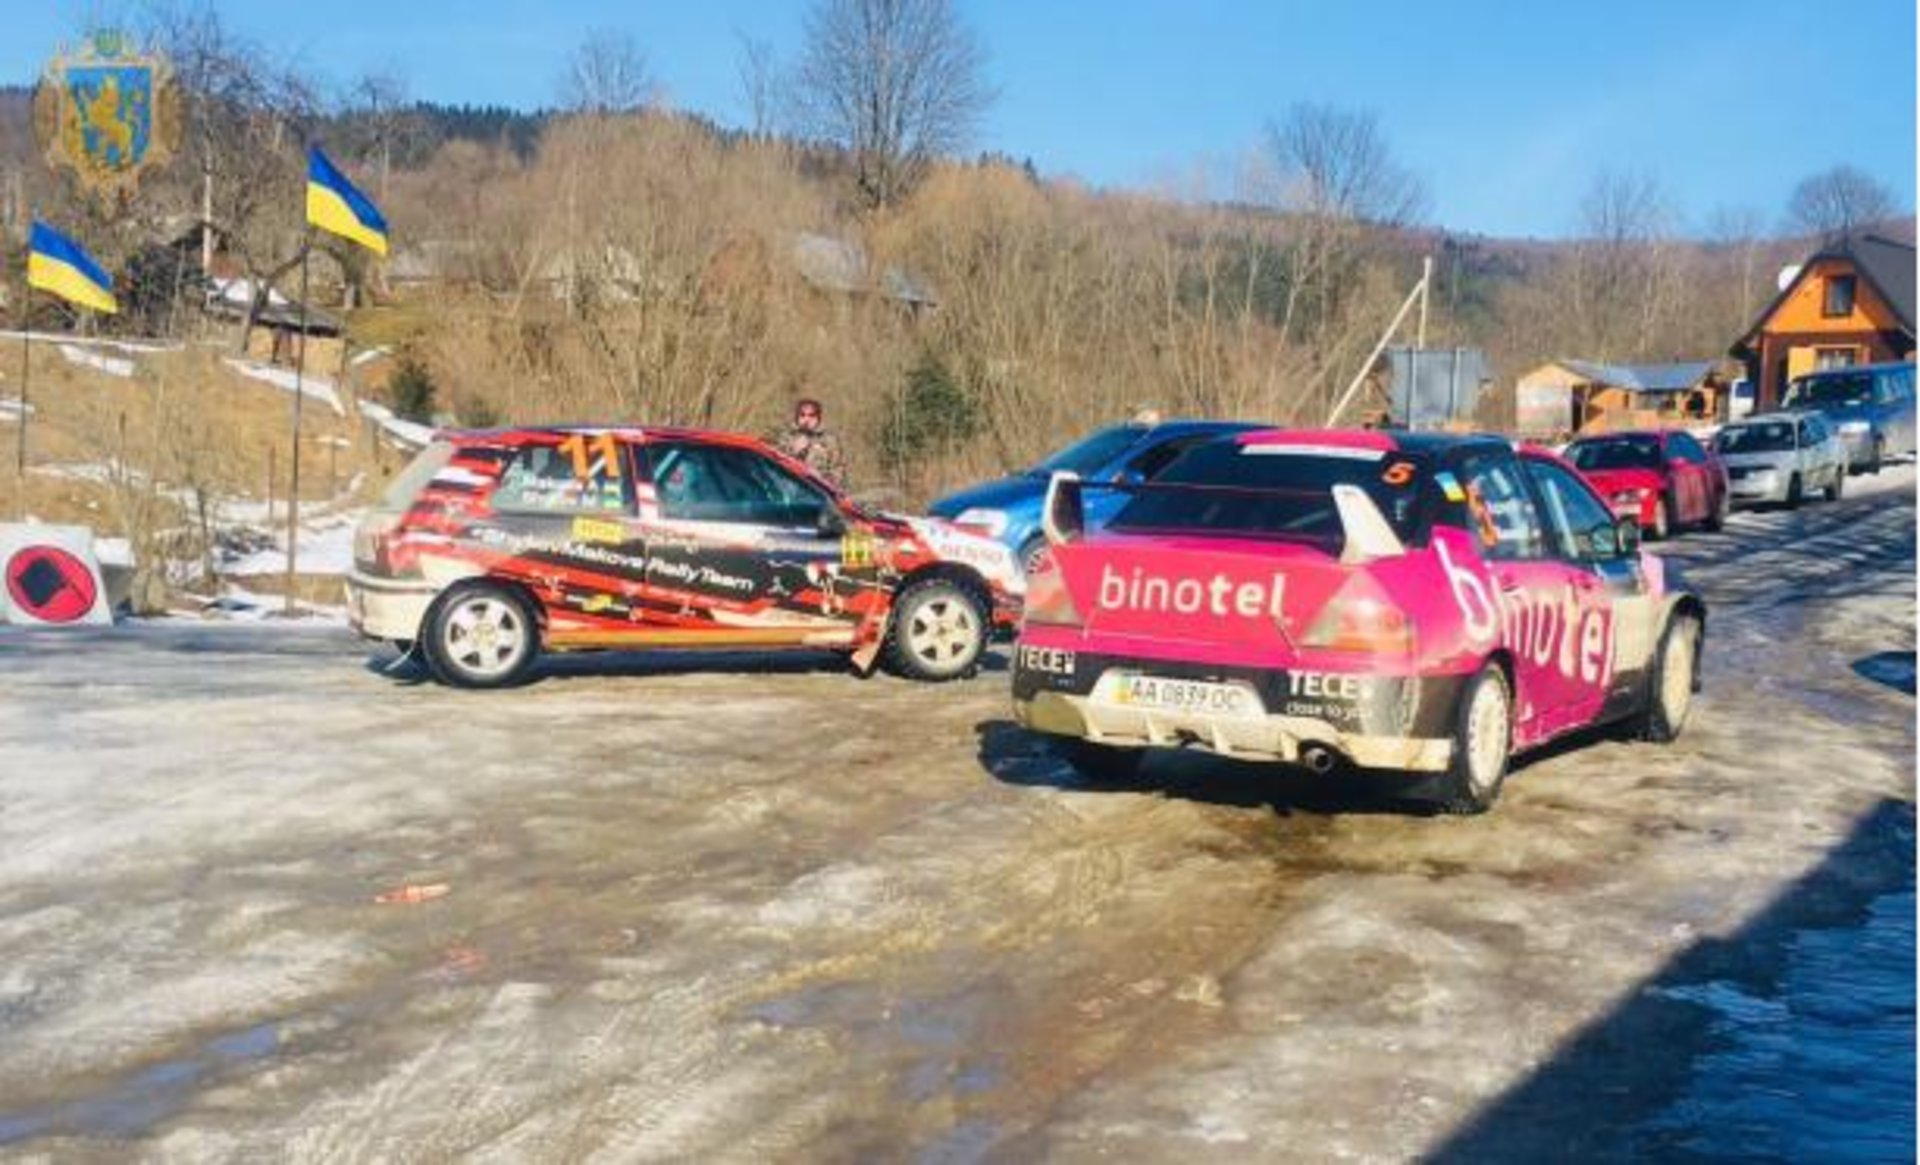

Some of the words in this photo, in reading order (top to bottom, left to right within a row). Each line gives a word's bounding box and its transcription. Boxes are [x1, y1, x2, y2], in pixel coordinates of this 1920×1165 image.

[557, 434, 621, 478] 11
[1100, 564, 1286, 618] binotel
[1287, 670, 1358, 699] TECE
